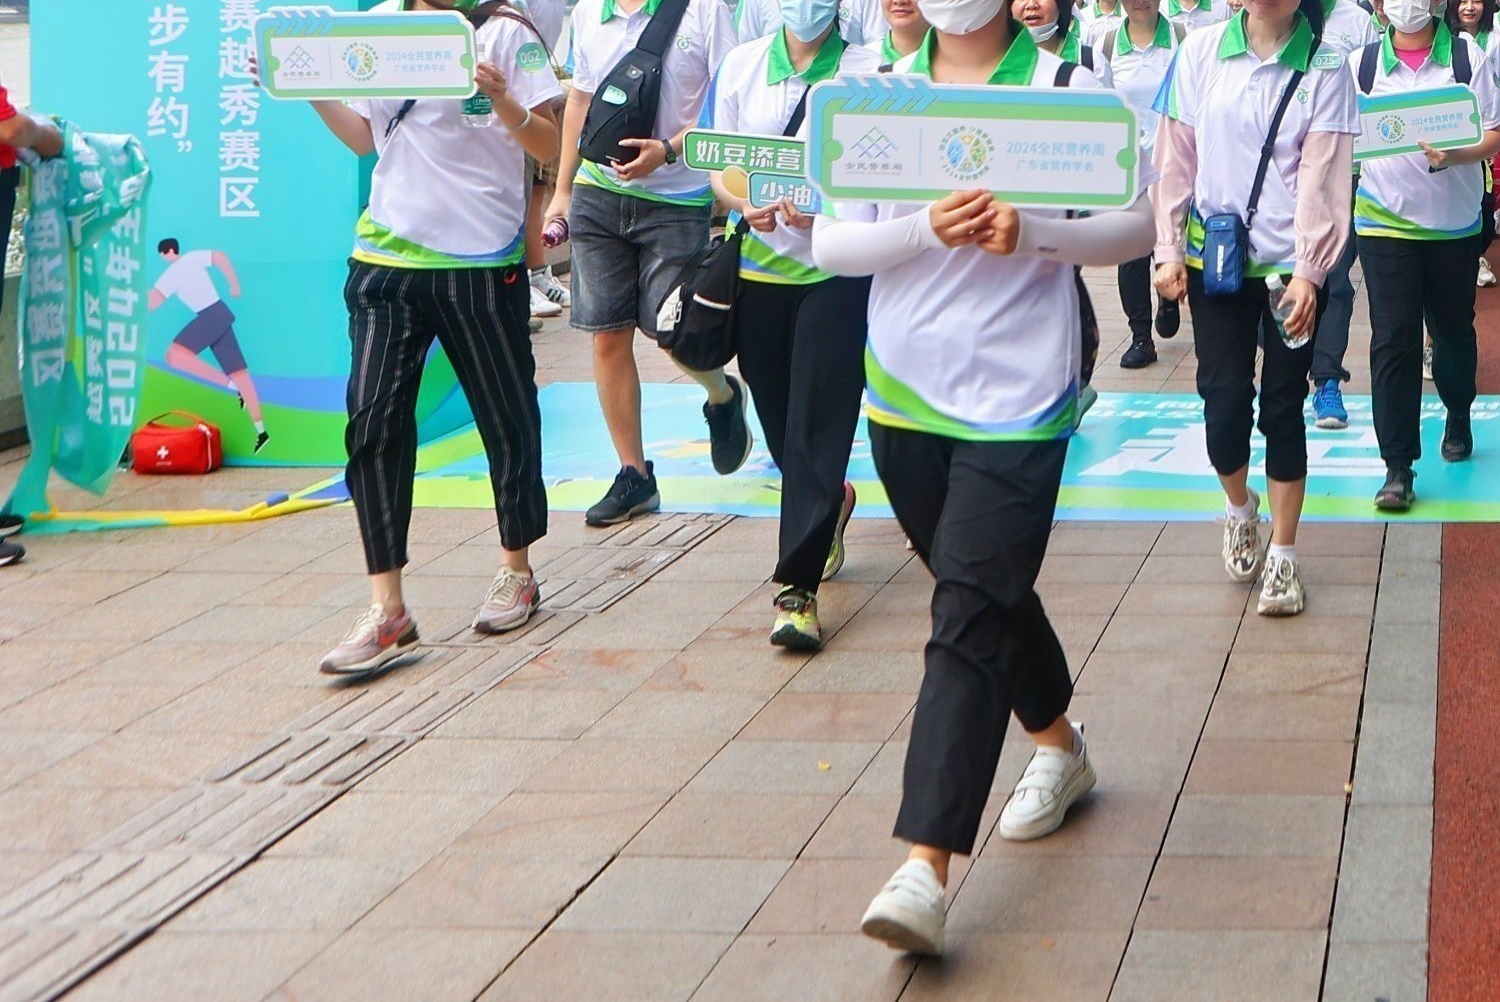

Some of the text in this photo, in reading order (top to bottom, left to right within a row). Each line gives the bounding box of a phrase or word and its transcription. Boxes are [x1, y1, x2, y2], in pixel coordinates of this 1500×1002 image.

[520, 49, 541, 64] 062
[1315, 56, 1335, 66] 025
[1007, 142, 1105, 157] 2024全民营养周
